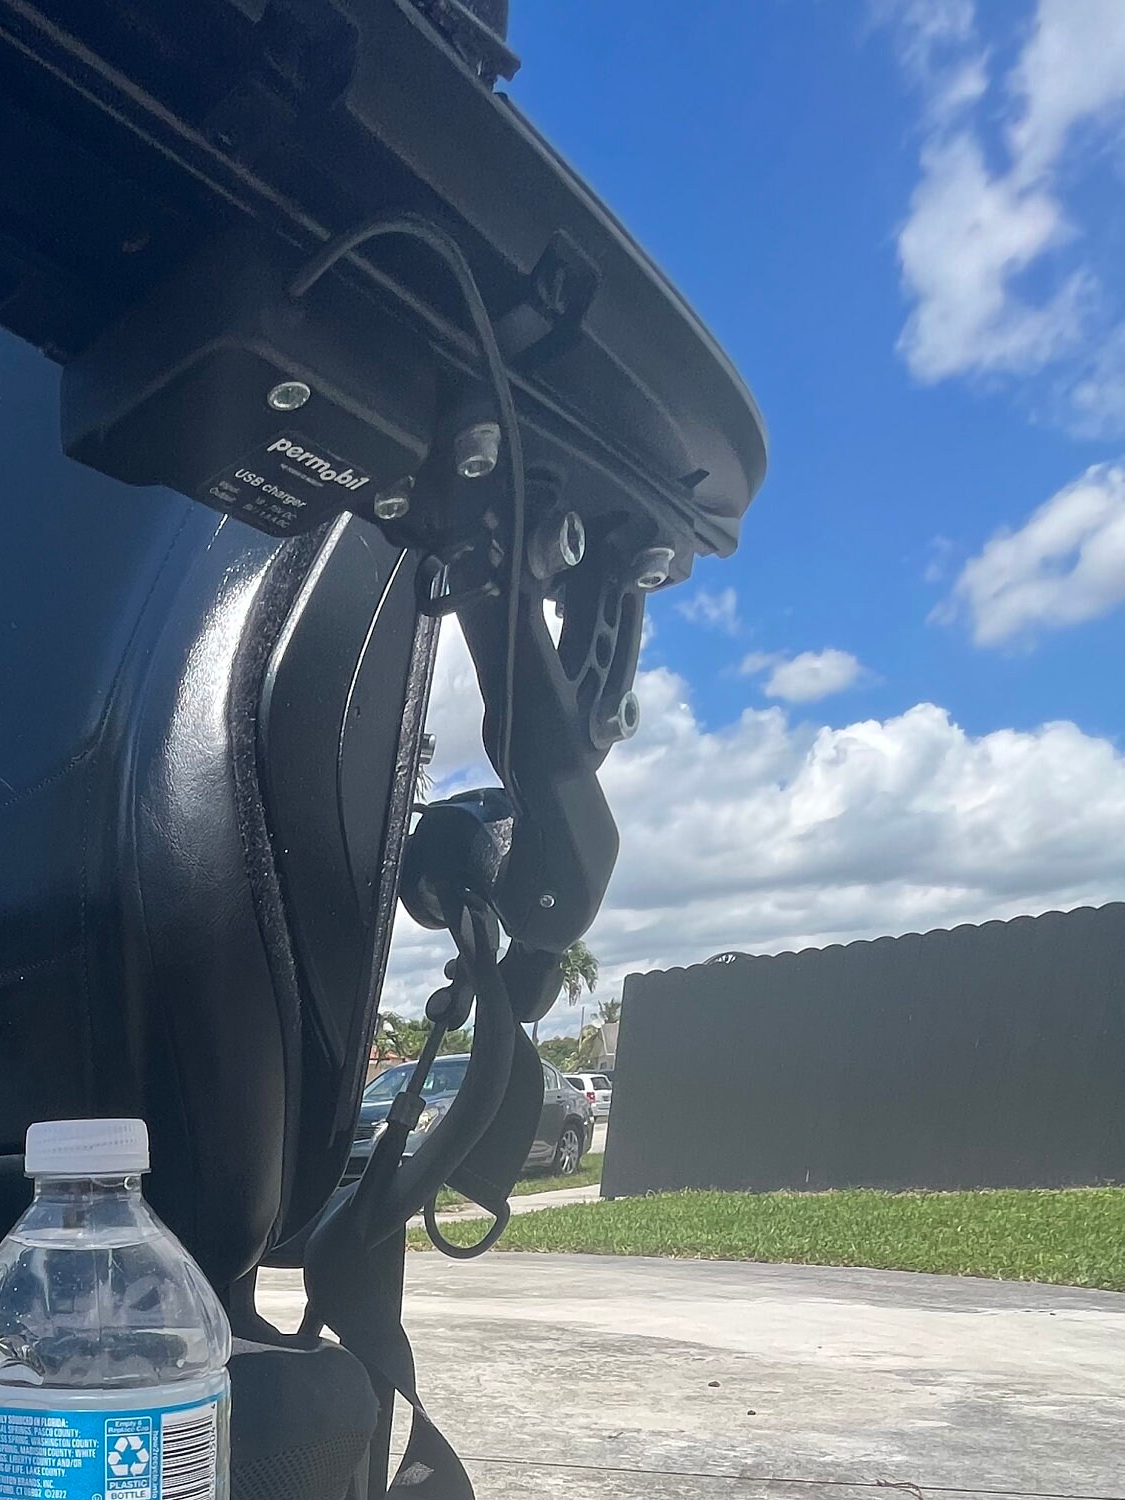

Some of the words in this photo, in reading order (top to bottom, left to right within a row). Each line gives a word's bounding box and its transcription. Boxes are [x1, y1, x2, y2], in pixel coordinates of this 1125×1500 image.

[267, 438, 370, 490] permobil
[235, 469, 265, 487] USB
[262, 482, 307, 508] charger
[34, 1427, 54, 1437] PASCO
[75, 1448, 96, 1458] WHITE
[32, 1456, 56, 1466] COUNTY
[26, 1466, 41, 1476] LAKE
[109, 1480, 148, 1490] PLASTIC
[111, 1490, 146, 1500] BOTTLE
